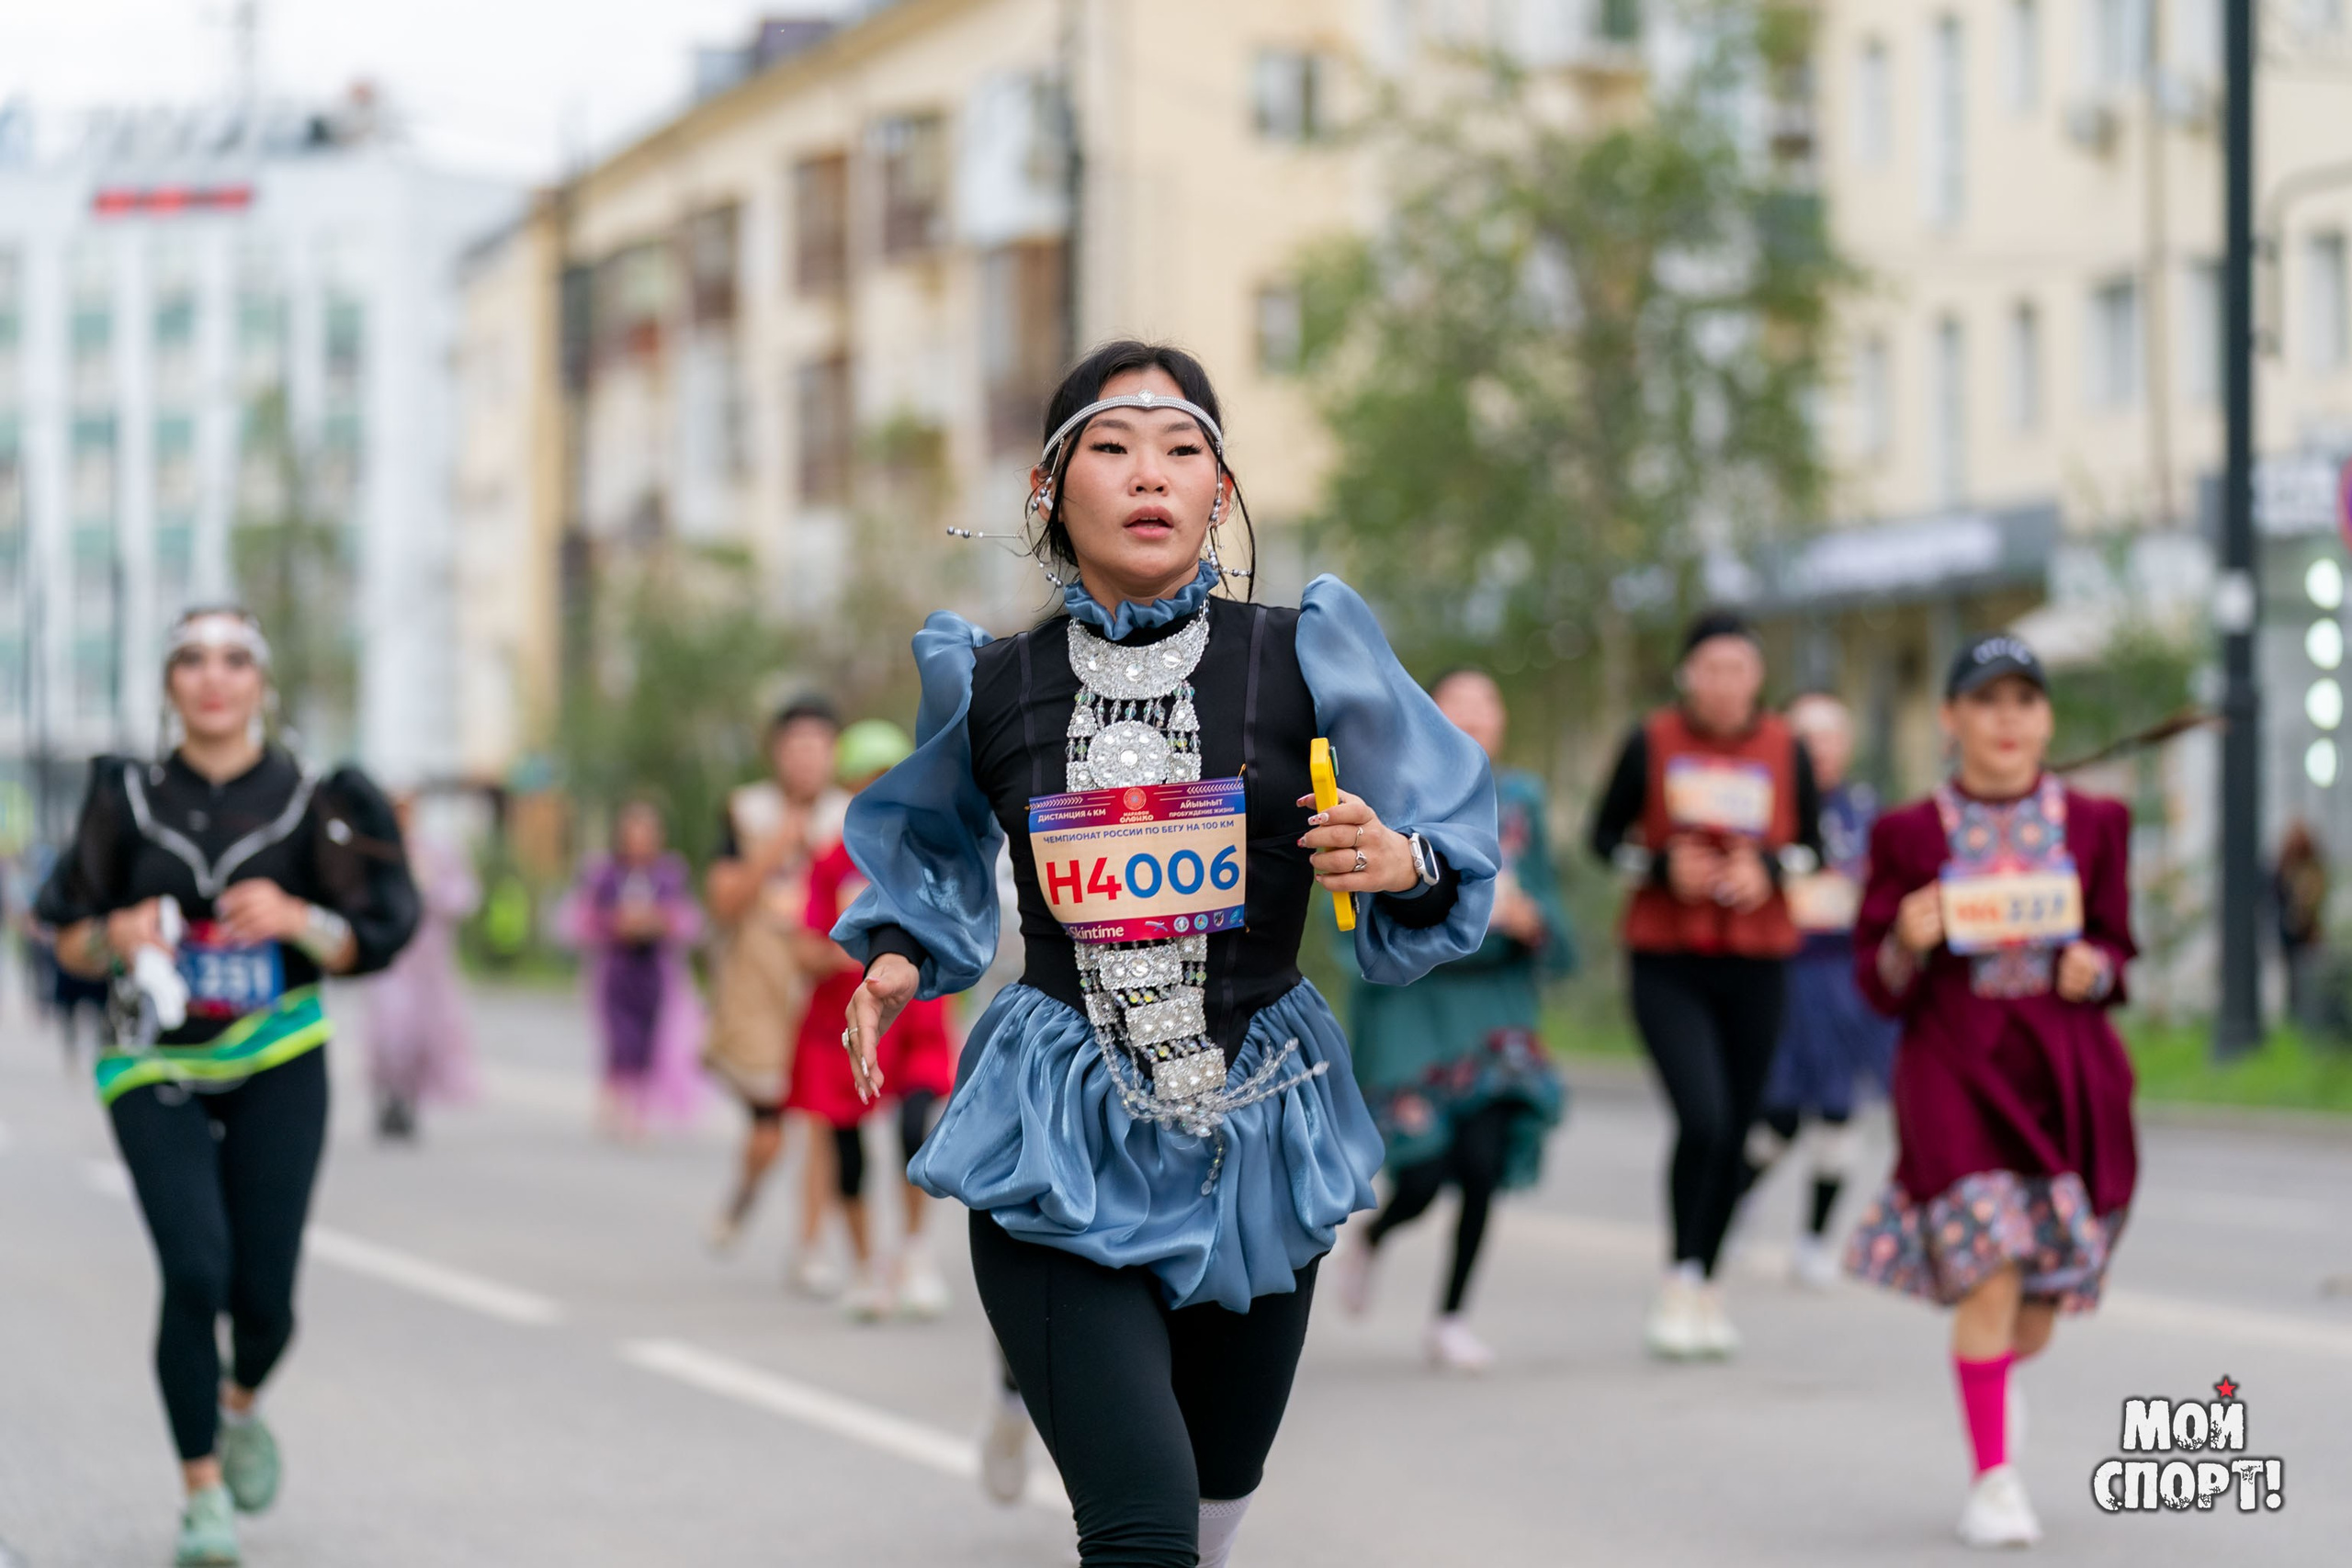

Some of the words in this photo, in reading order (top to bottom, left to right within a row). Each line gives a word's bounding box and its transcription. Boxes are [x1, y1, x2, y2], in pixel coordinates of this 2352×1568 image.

[1037, 810, 1086, 823] ДИСТАНЦИЯ
[1093, 808, 1106, 817] КМ
[1169, 808, 1213, 818] ПРОБУЖДЕНИЕ
[1213, 807, 1235, 815] ЖИЗНИ
[1043, 831, 1101, 844] ЧЕМПИОНАТ
[1103, 828, 1143, 838] РОССИИ
[1145, 827, 1159, 835] ПО
[1161, 824, 1184, 833] БЕГУ
[1186, 823, 1200, 831] НА
[1202, 821, 1218, 829] 100
[1046, 844, 1239, 906] Н4006
[1069, 924, 1125, 940] Skintime
